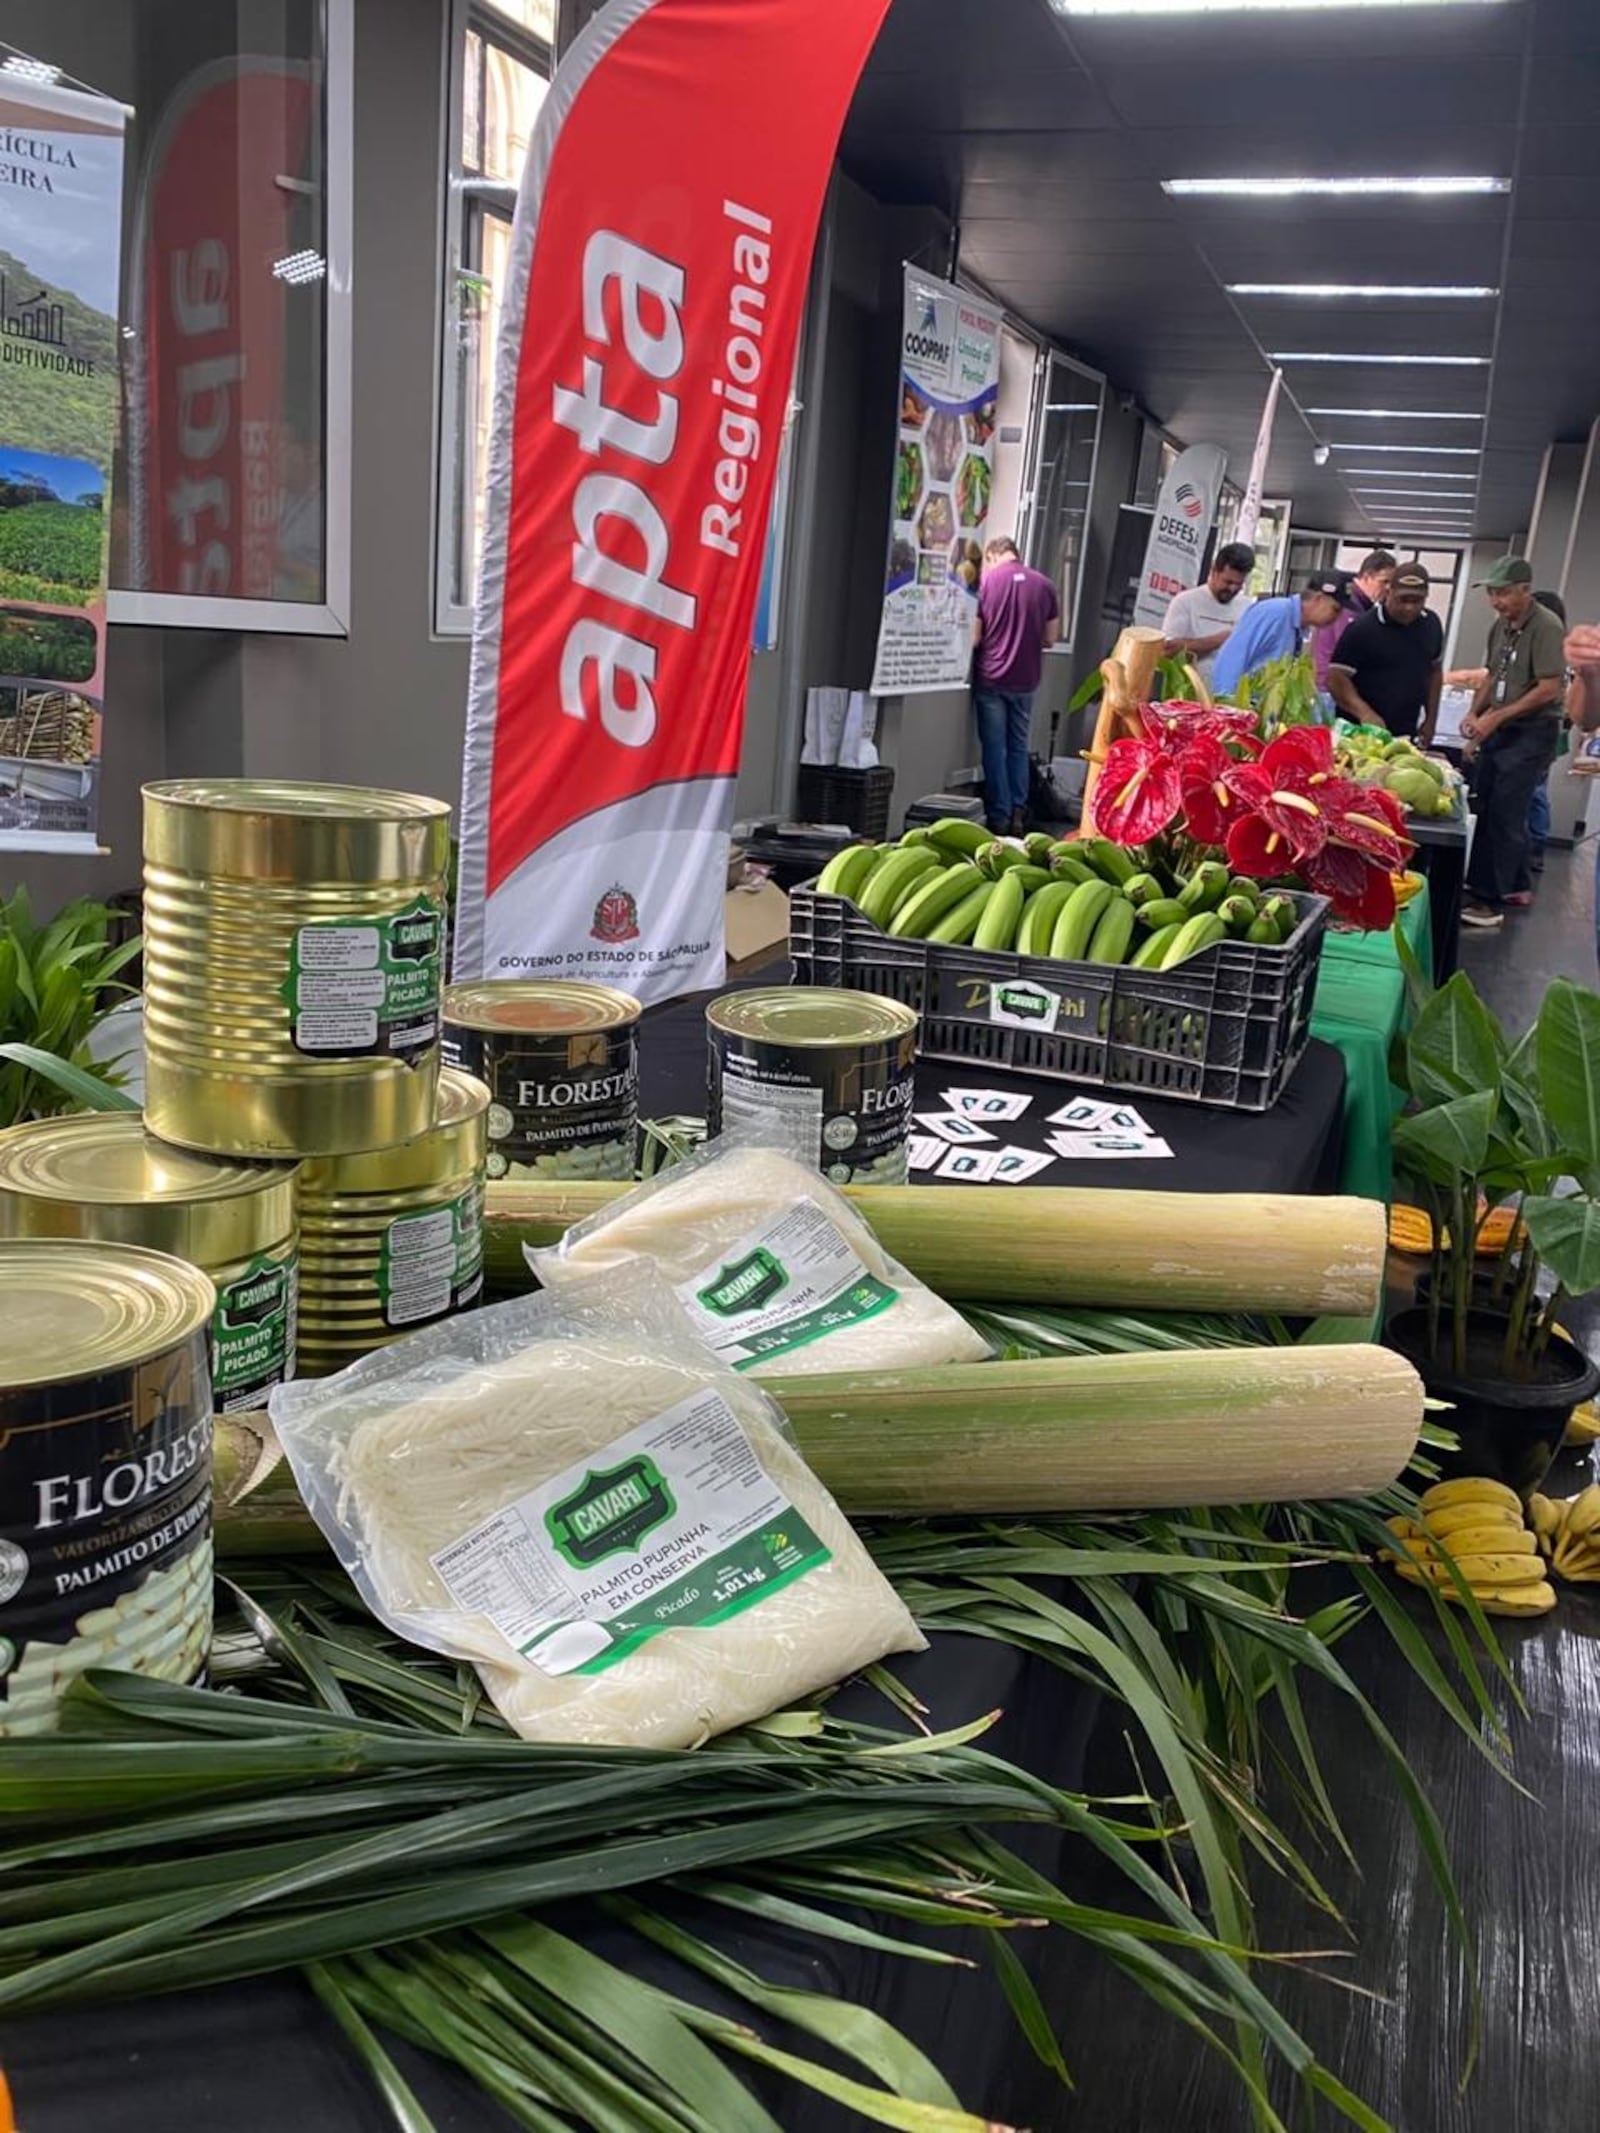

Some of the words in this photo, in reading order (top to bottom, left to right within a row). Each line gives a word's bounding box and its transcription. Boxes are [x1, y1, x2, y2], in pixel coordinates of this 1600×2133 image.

[0, 128, 77, 168] ÍCULA
[0, 342, 95, 378] DUTIVIDADE
[700, 199, 774, 558] Regional
[552, 229, 697, 747] apta
[387, 969, 429, 986] PALMITO
[499, 955, 563, 969] GOVERNO
[566, 952, 583, 964] DO
[587, 950, 634, 962] ESTADO
[639, 950, 654, 962] DE
[389, 987, 426, 1003] PICADO
[525, 1127, 575, 1141] PALMITO
[576, 1125, 590, 1136] DE
[717, 1262, 764, 1306] CAVARI
[221, 1328, 272, 1356] PALMITO
[224, 1346, 269, 1373] PICADO
[574, 1480, 642, 1535] CAVARI
[55, 1541, 149, 1596] PALMITO
[151, 1526, 175, 1552] DE
[580, 1562, 643, 1606] PALMITO
[643, 1522, 713, 1572] PUPUNHA
[607, 1590, 633, 1611] EM
[632, 1544, 709, 1596] CONSERVA
[711, 1576, 747, 1603] 1,01
[742, 1567, 767, 1584] kg
[653, 1586, 701, 1621] Picado
